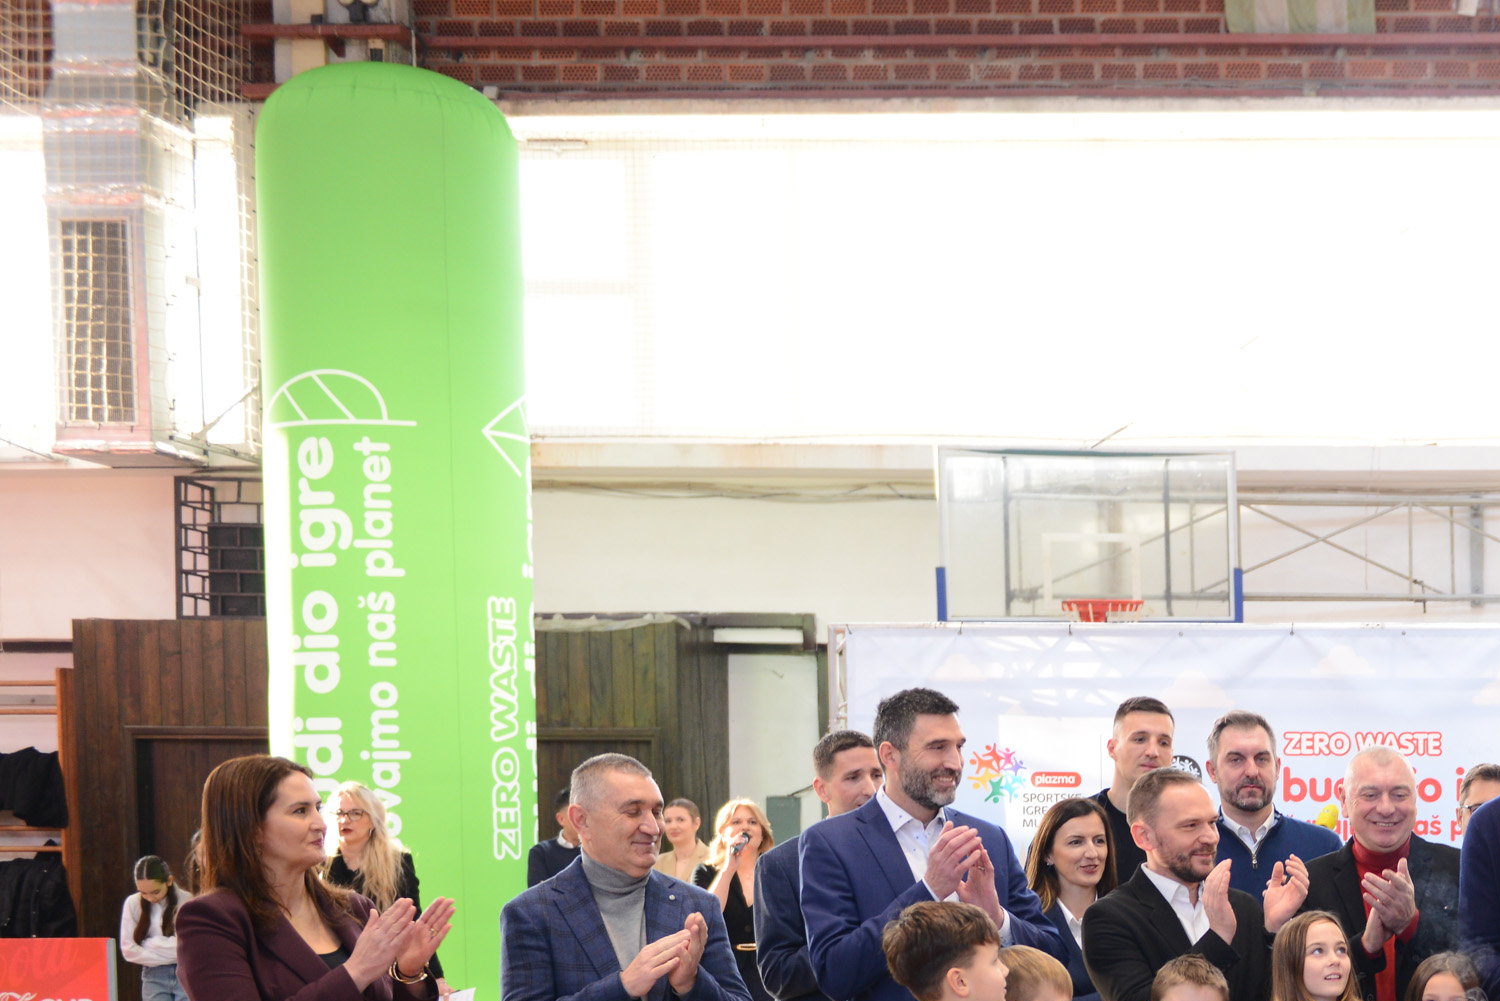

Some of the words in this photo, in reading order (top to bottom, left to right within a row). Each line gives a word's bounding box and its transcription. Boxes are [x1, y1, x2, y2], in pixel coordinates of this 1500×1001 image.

[290, 436, 353, 568] igre
[353, 436, 406, 577] planet
[292, 590, 341, 694] dio
[357, 591, 397, 667] naš
[487, 596, 518, 742] WASTE
[1034, 773, 1076, 787] plazma
[1283, 731, 1350, 756] ZERO
[1355, 731, 1442, 756] WASTE
[492, 747, 521, 860] ZERO
[1022, 805, 1048, 816] IGRE
